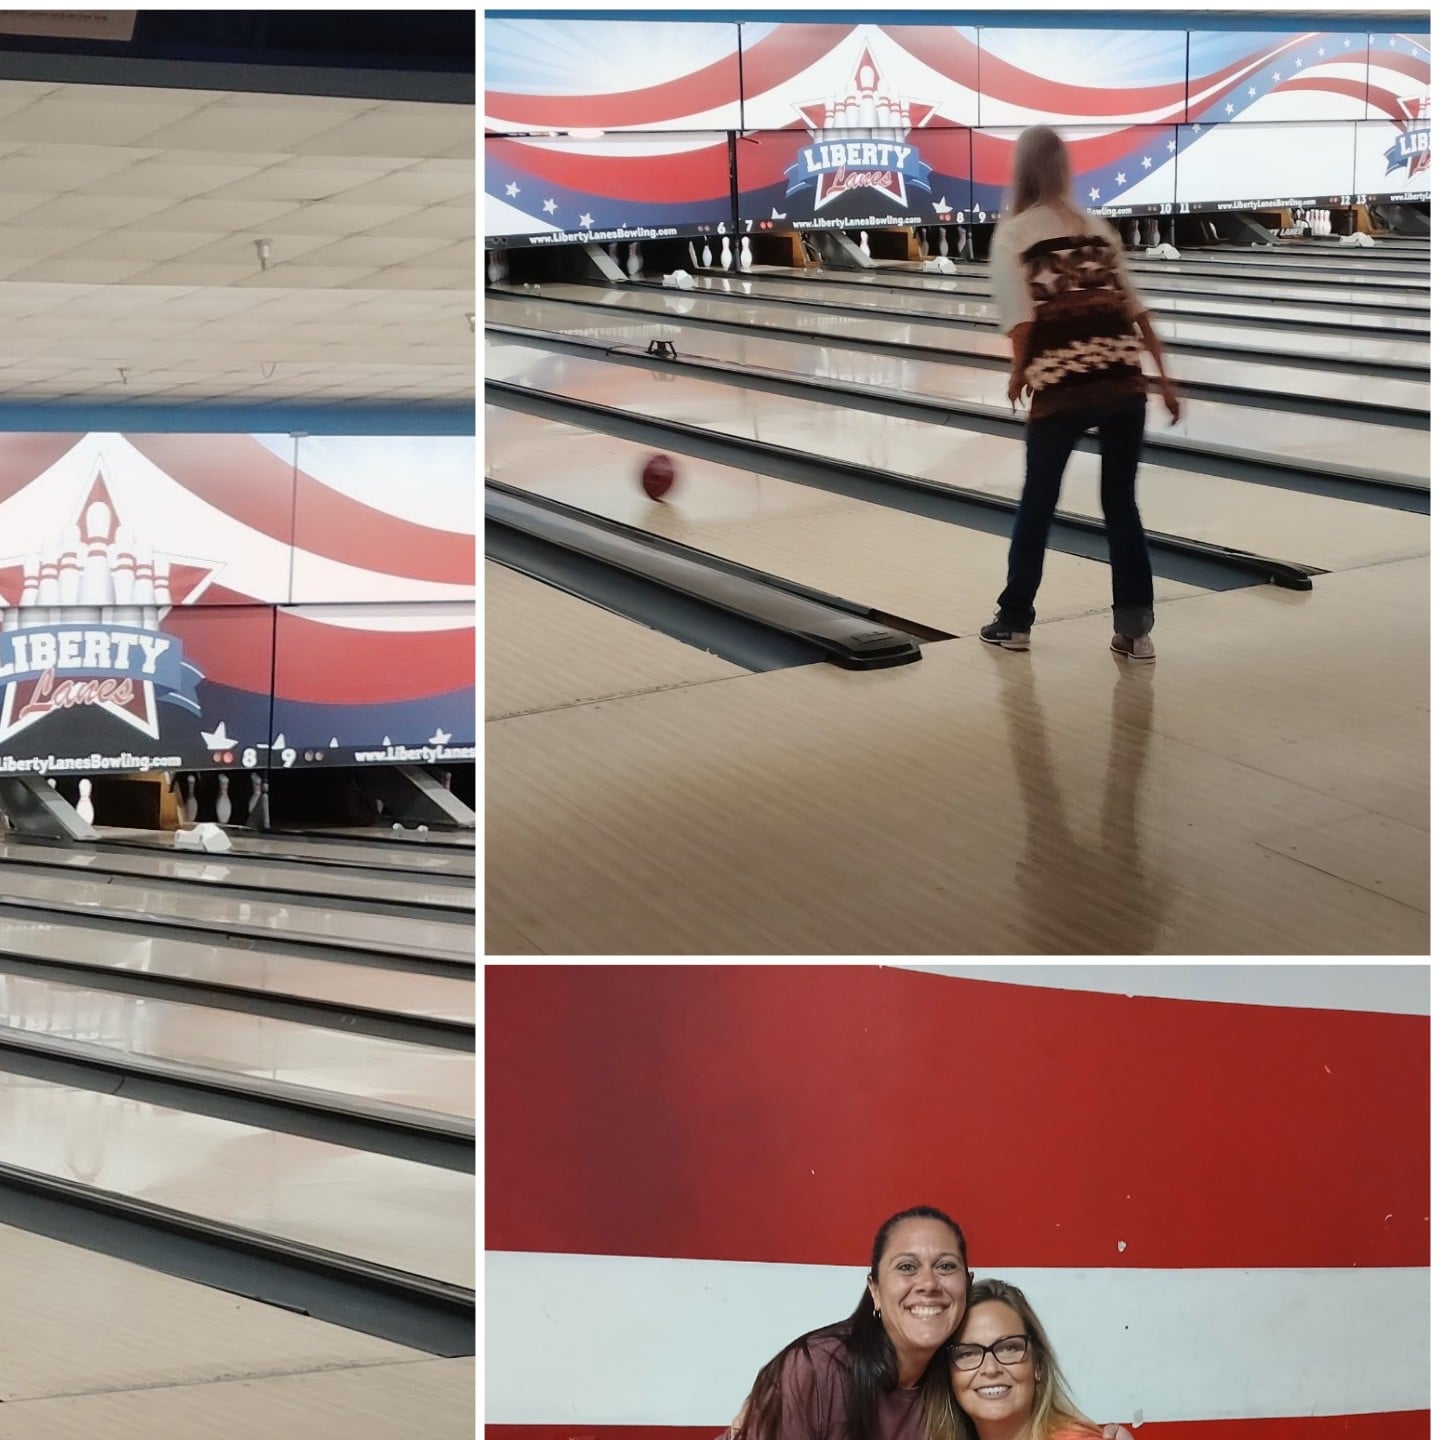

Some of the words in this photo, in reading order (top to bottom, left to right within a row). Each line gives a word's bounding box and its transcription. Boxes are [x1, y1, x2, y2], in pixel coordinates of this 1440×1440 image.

[1400, 133, 1429, 155] LIB
[803, 144, 911, 171] LIBERTY
[825, 166, 893, 195] Lanes
[1218, 199, 1316, 211] www.LibertyLanesBowling.com
[1340, 195, 1351, 205] 12
[1357, 195, 1367, 204] 13
[1086, 206, 1132, 218] Bowling.com
[1160, 203, 1171, 214] 10
[1180, 203, 1190, 213] 11
[792, 216, 921, 229] www.LibertyLanesBowling.com
[956, 212, 964, 222] 8
[978, 212, 986, 222] 9
[717, 222, 726, 233] 6
[744, 220, 753, 232] 7
[529, 228, 677, 245] www.LibertyLanesBowling.com
[18, 670, 135, 719] Lanes
[242, 748, 257, 767] 8
[282, 747, 296, 768] 9
[355, 746, 475, 765] www.LibertyLanes
